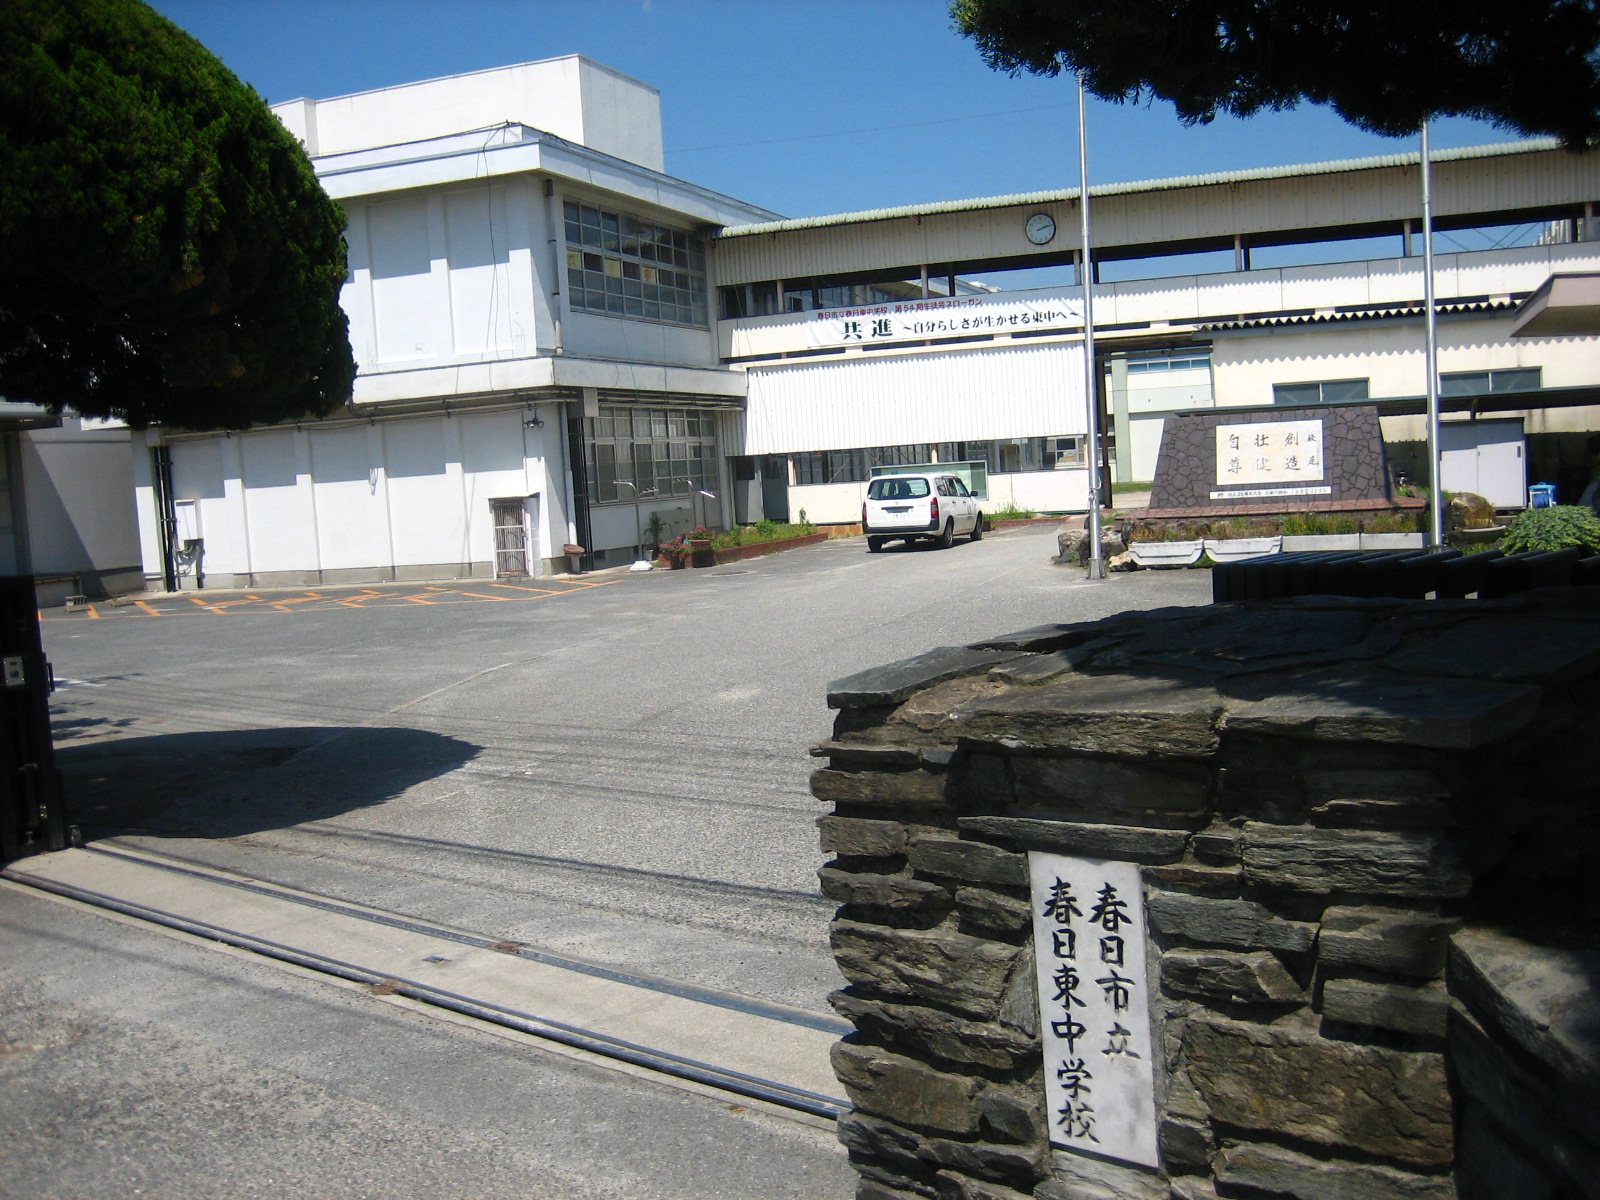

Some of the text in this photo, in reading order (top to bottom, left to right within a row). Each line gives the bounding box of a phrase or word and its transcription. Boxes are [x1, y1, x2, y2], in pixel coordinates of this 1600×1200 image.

[1284, 432, 1301, 471] 創造
[1042, 876, 1100, 1144] 春日東中学校
[1088, 881, 1141, 1060] 春日市立
